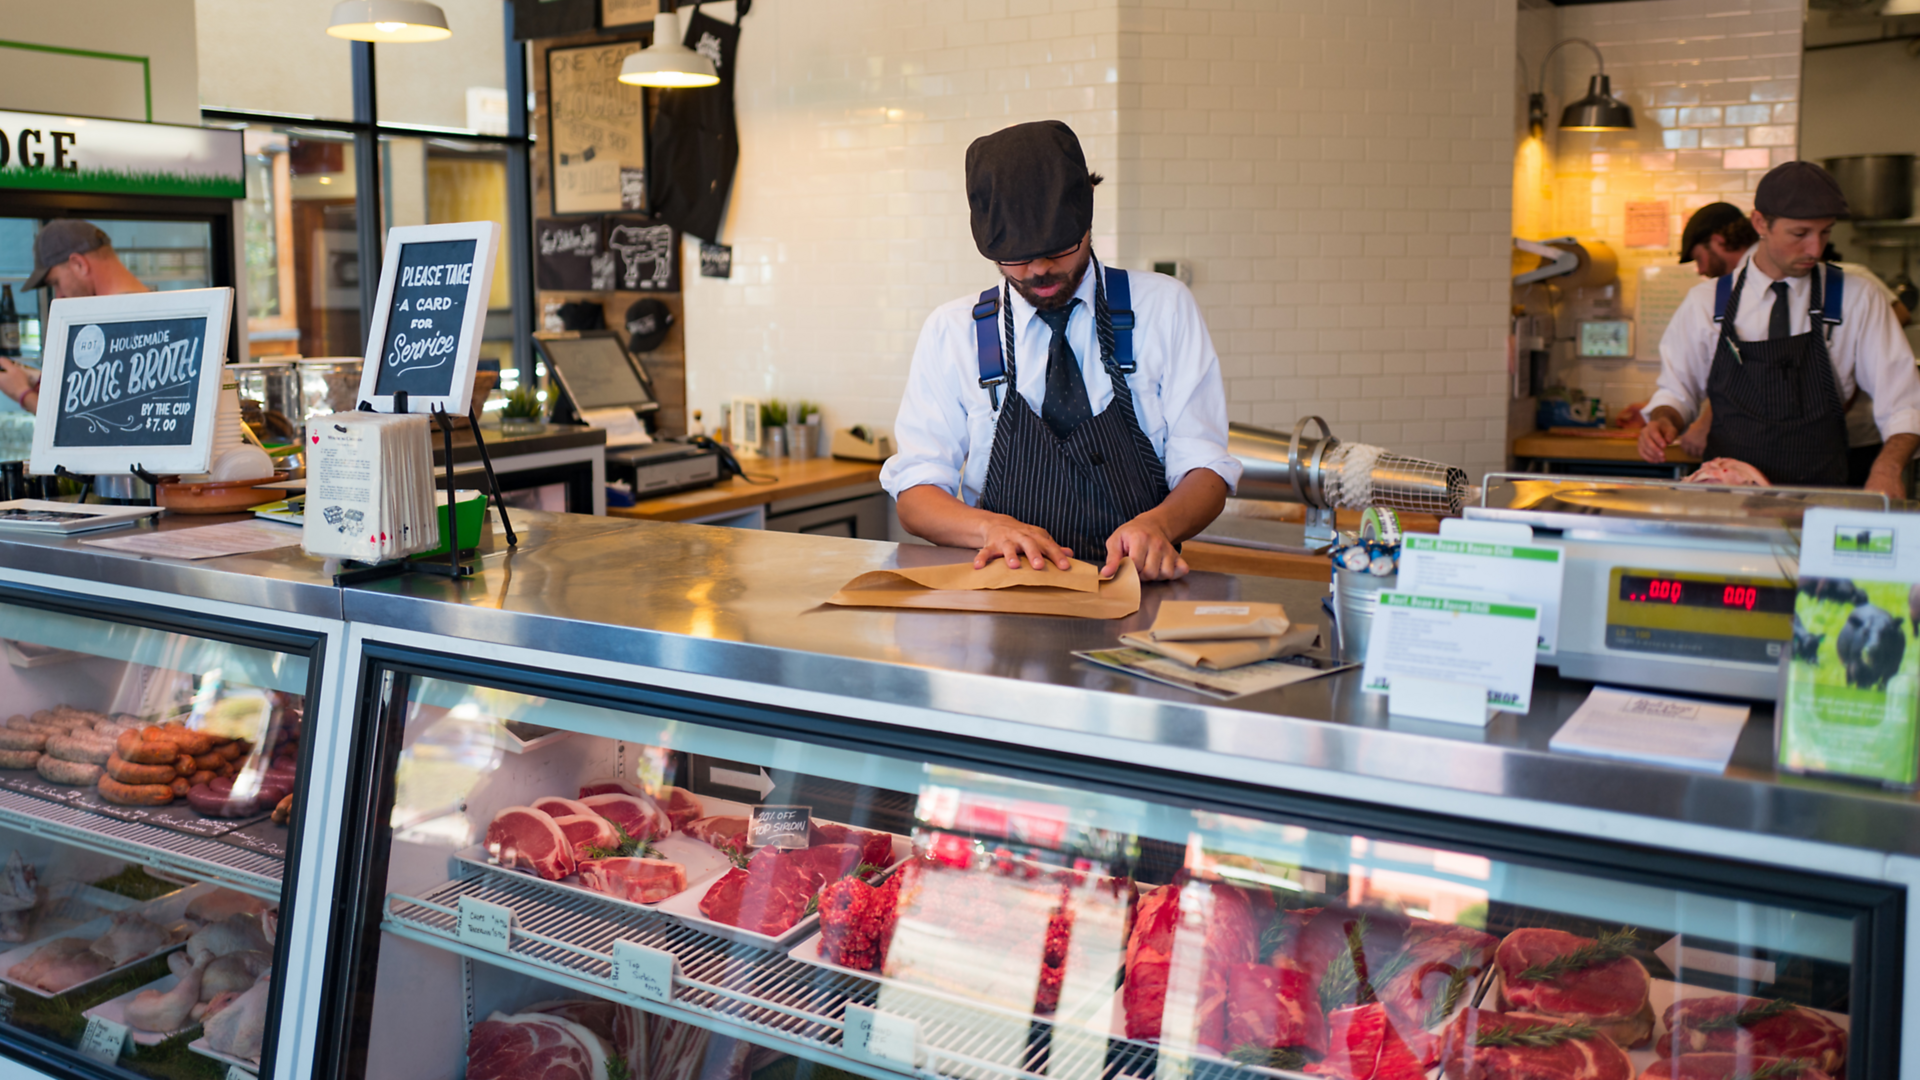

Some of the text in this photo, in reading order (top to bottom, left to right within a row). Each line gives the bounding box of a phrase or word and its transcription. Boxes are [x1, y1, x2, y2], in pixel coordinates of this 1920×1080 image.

[401, 263, 473, 287] PLEASE TAKE
[416, 297, 452, 311] CARD
[410, 318, 433, 330] FOR
[80, 340, 98, 351] HOT
[110, 330, 170, 353] HOUSEMADE
[388, 330, 455, 367] Service
[127, 337, 199, 395] BROTH
[141, 402, 191, 416] BY THE CUP
[146, 417, 177, 432] $7.00
[757, 811, 797, 823] 20% OFF
[753, 821, 806, 835] TOP SIRLOIN
